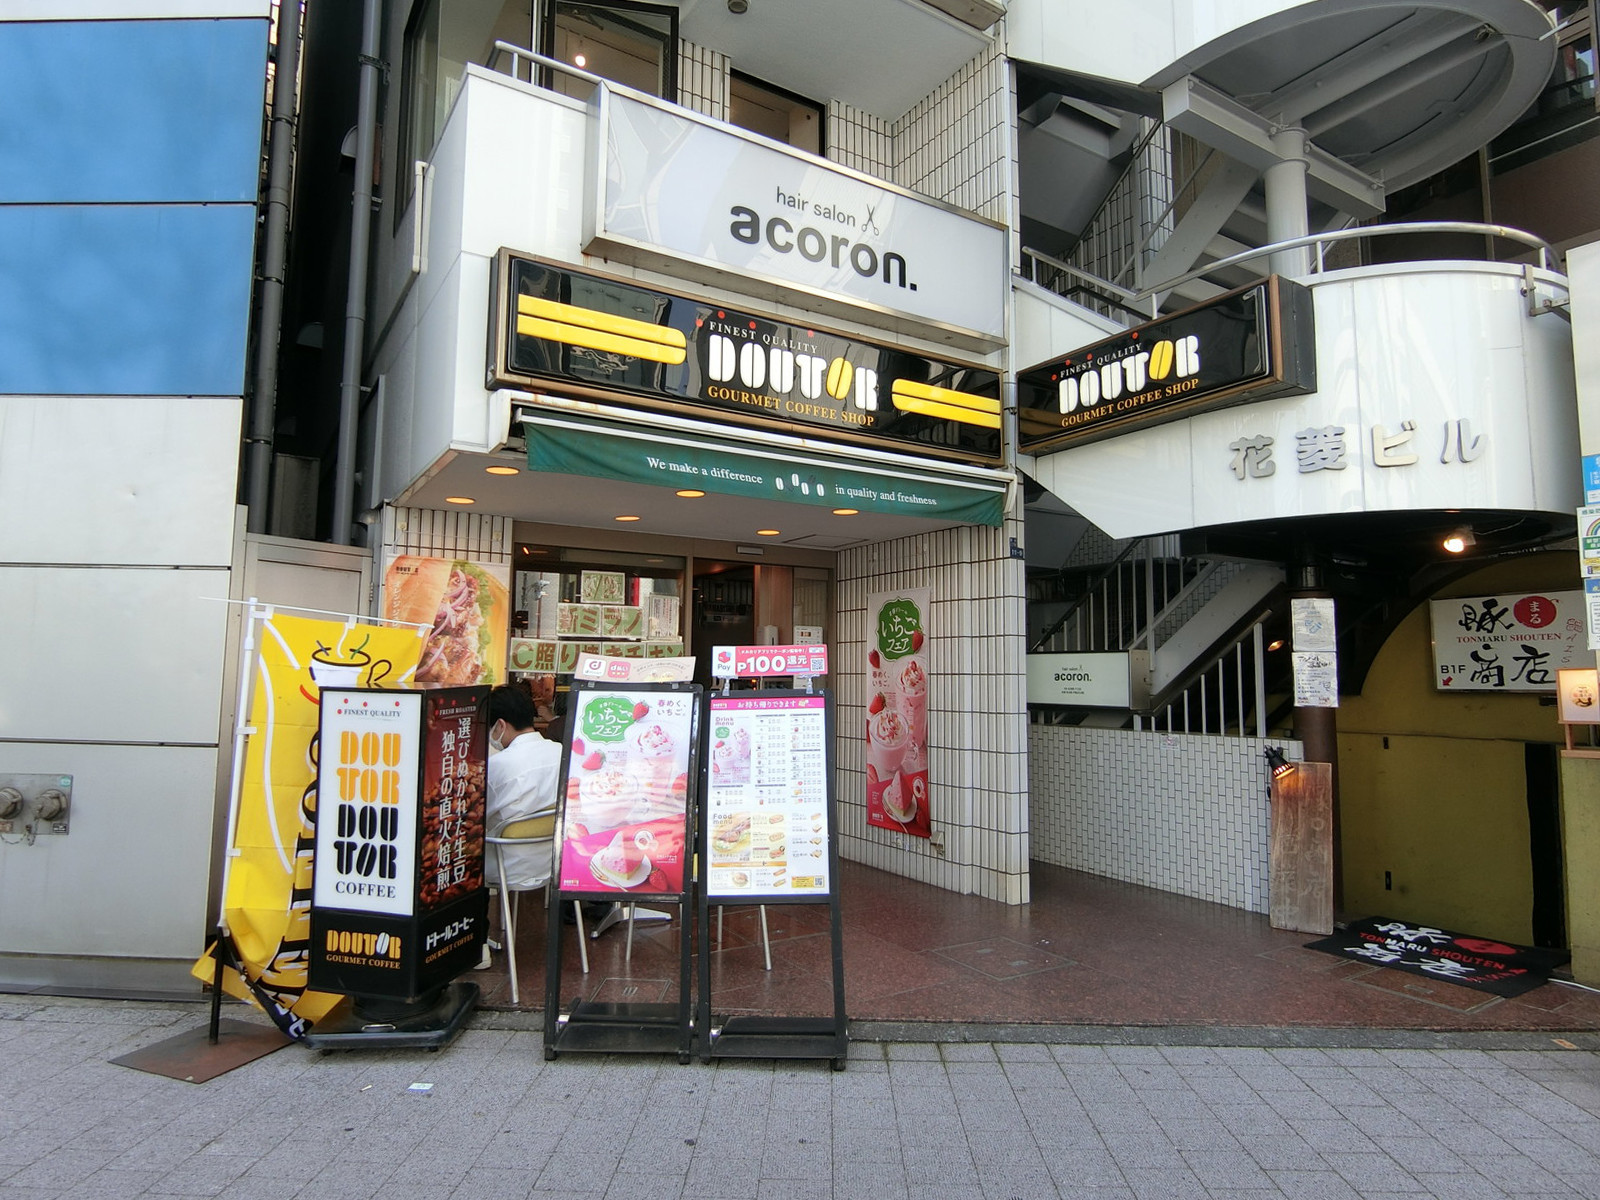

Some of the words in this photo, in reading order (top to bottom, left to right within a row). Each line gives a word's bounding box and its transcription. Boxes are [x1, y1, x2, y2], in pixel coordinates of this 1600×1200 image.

[776, 186, 809, 212] hair
[813, 204, 857, 227] salon
[730, 205, 918, 292] acoron.
[709, 321, 757, 340] FINEST
[762, 334, 819, 354] QUALITY
[708, 334, 878, 411] DOUTOR
[1058, 335, 1200, 415] DOUTOR
[1059, 360, 1093, 379] FINEST
[1097, 342, 1142, 366] QUALITY
[707, 385, 781, 410] GOURMET
[785, 400, 837, 420] COFFEE
[841, 410, 874, 427] SHOP
[1061, 403, 1114, 428] GOURMET
[1117, 389, 1162, 411] COFFEE
[1165, 378, 1199, 397] SHOP
[1228, 418, 1489, 481] 花菱ビル
[647, 456, 667, 470] We
[669, 462, 699, 475] make
[701, 468, 708, 476] a
[710, 467, 764, 484] difference
[835, 484, 845, 495] in
[847, 487, 878, 501] quality
[879, 491, 896, 502] and
[897, 491, 937, 505] freshness
[881, 615, 918, 639] いちご
[1529, 601, 1541, 624] まる
[886, 638, 909, 651] フェア
[1456, 634, 1508, 644] TONMARU
[1509, 632, 1562, 643] SHOUTEN
[717, 663, 730, 671] Pay
[1440, 664, 1467, 674] B1F
[344, 708, 368, 716] FINEST
[439, 708, 455, 716] FRESH
[455, 705, 477, 713] ROASTED
[588, 707, 634, 725] いちご
[592, 725, 622, 736] フェア
[340, 730, 401, 767] DOU
[336, 767, 400, 804] TOR
[453, 717, 472, 886] 選びぬかれた生豆
[338, 804, 398, 842] DOU
[436, 730, 456, 893] 独自の直火焙煎
[333, 841, 397, 879] TOR
[335, 881, 396, 899] COFFEE
[326, 930, 402, 959] DOUTOR
[425, 944, 453, 964] GOURMET
[454, 933, 474, 948] COFFEE
[426, 917, 475, 951] ドトールコーヒー
[326, 953, 367, 966] GOURMET
[368, 959, 401, 970] COFFEE
[1359, 932, 1428, 953] TONMARU
[1431, 948, 1504, 970] SHOUTEN
